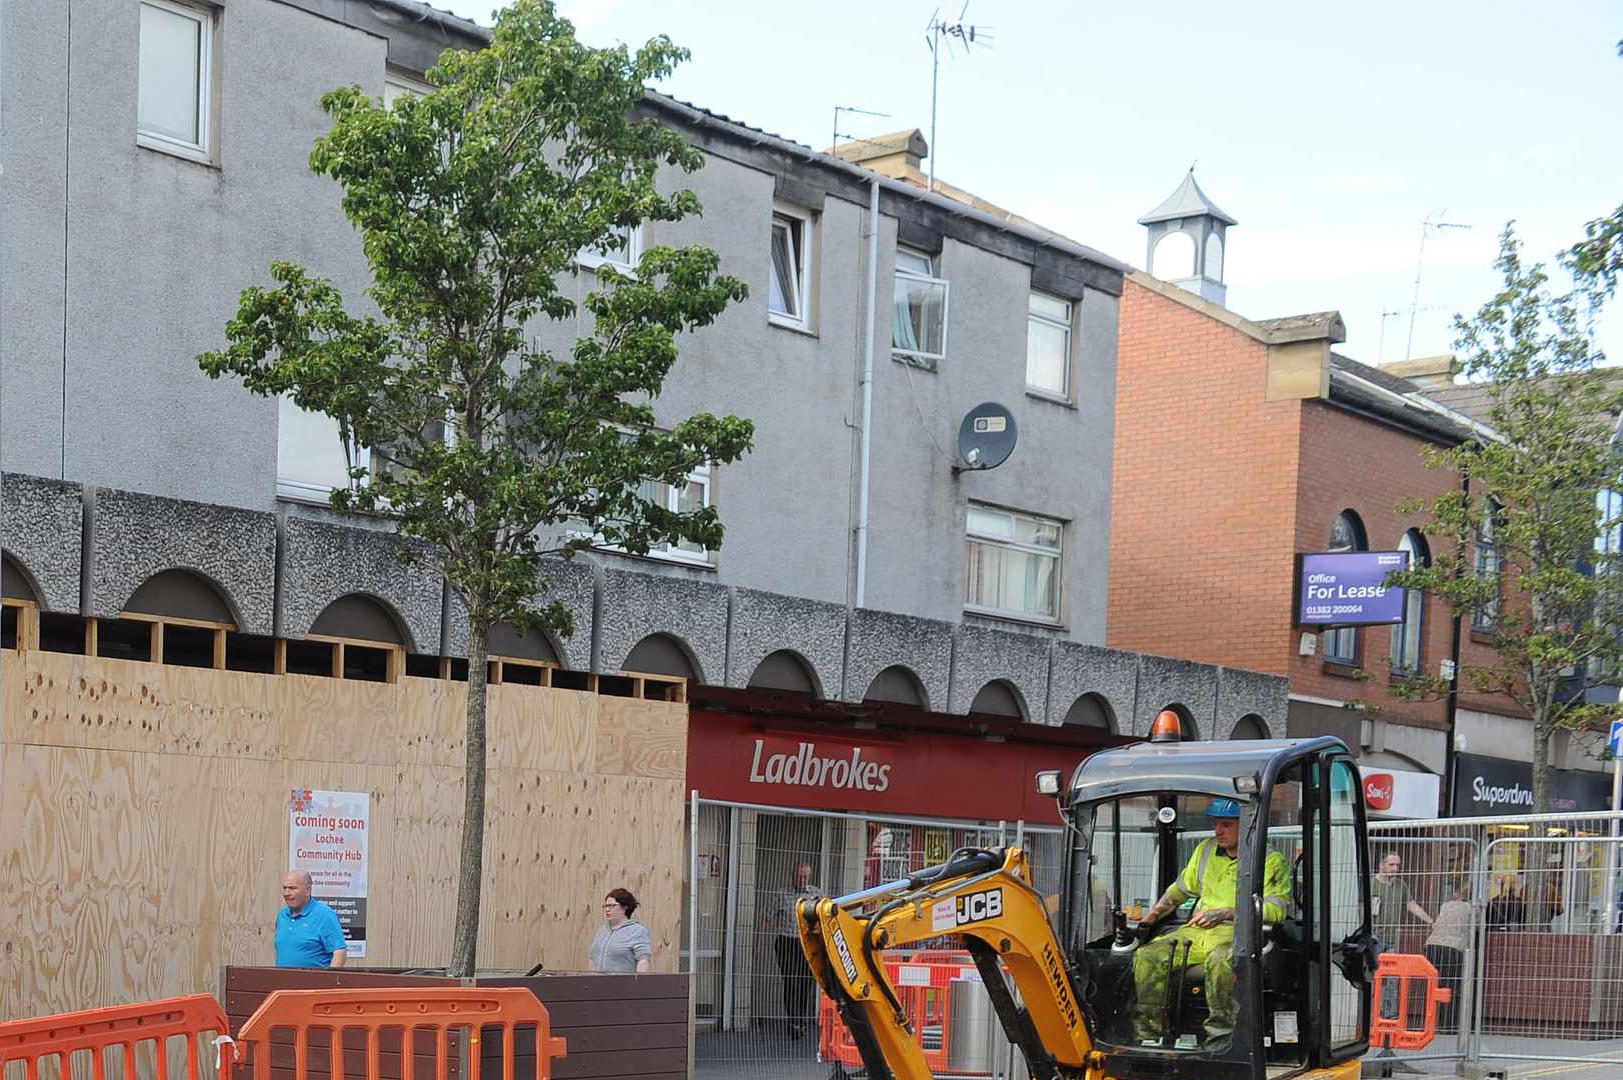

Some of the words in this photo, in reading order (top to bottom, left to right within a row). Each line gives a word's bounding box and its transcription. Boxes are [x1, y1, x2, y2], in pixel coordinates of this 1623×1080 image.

[1308, 574, 1336, 584] Office
[1307, 585, 1335, 600] For
[1338, 584, 1385, 599] Lease
[1306, 606, 1331, 614] 01382
[1332, 605, 1363, 613] 200064
[749, 739, 891, 792] Ladbrokes
[1472, 776, 1534, 808] Superdru
[295, 814, 336, 831] coming
[338, 818, 365, 830] soon
[315, 833, 344, 844] Lochee
[297, 848, 344, 862] Community
[345, 850, 362, 860] Hub
[957, 890, 1002, 923] JCB
[1044, 942, 1077, 1028] HEWDEN
